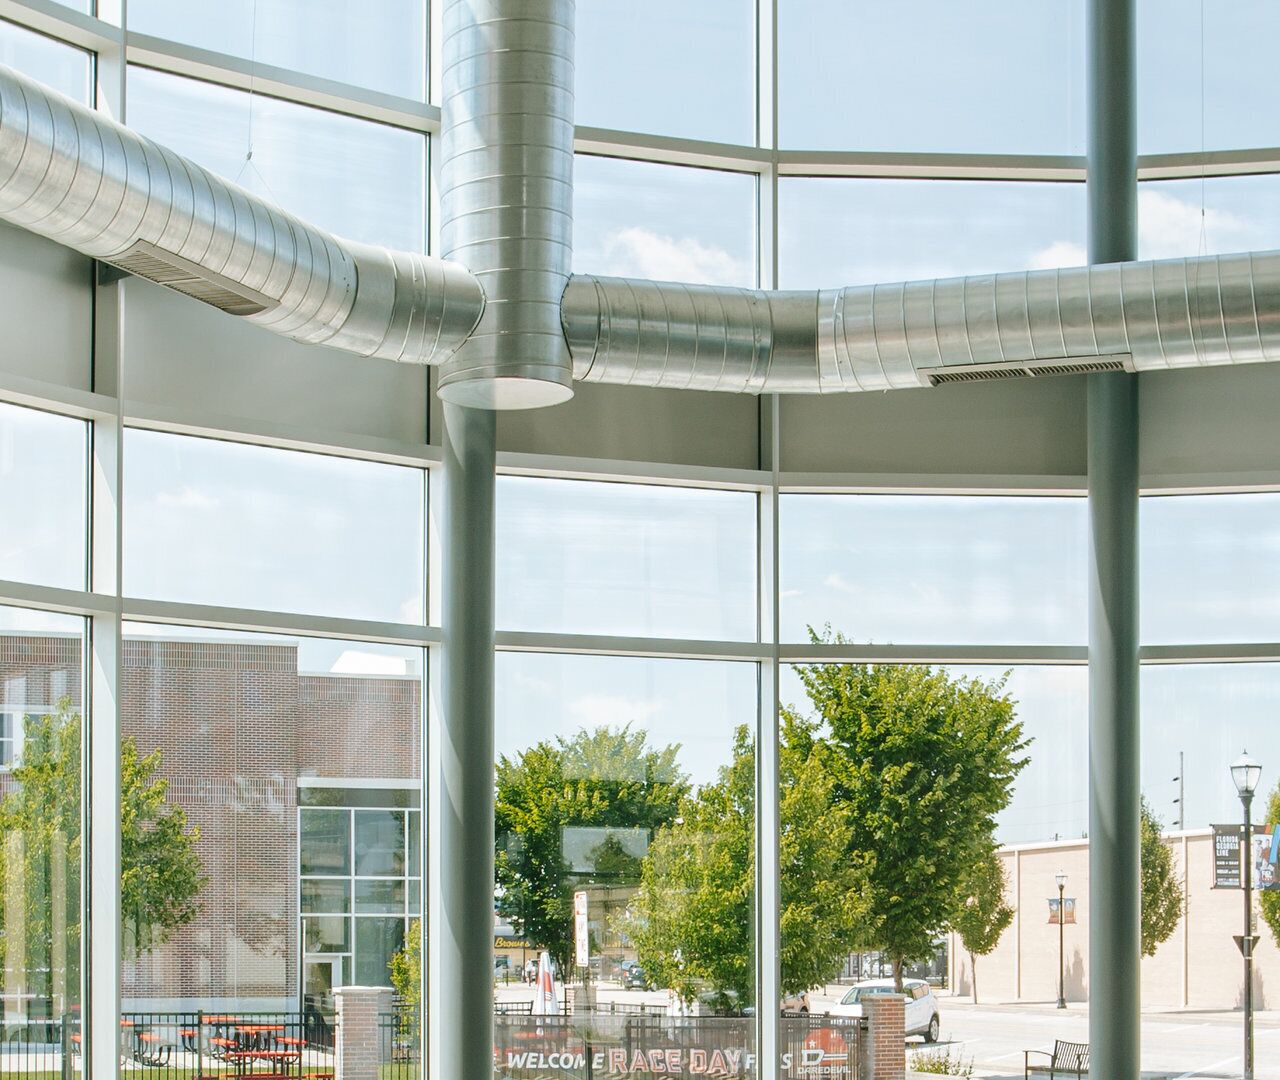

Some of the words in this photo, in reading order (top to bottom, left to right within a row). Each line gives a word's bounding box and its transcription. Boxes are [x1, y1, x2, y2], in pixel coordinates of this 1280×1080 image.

[507, 1052, 605, 1069] WELCOME
[608, 1048, 683, 1074] RACE
[689, 1048, 742, 1074] DAY
[745, 1053, 793, 1070] FS
[797, 1065, 851, 1075] DAREDEVIL
